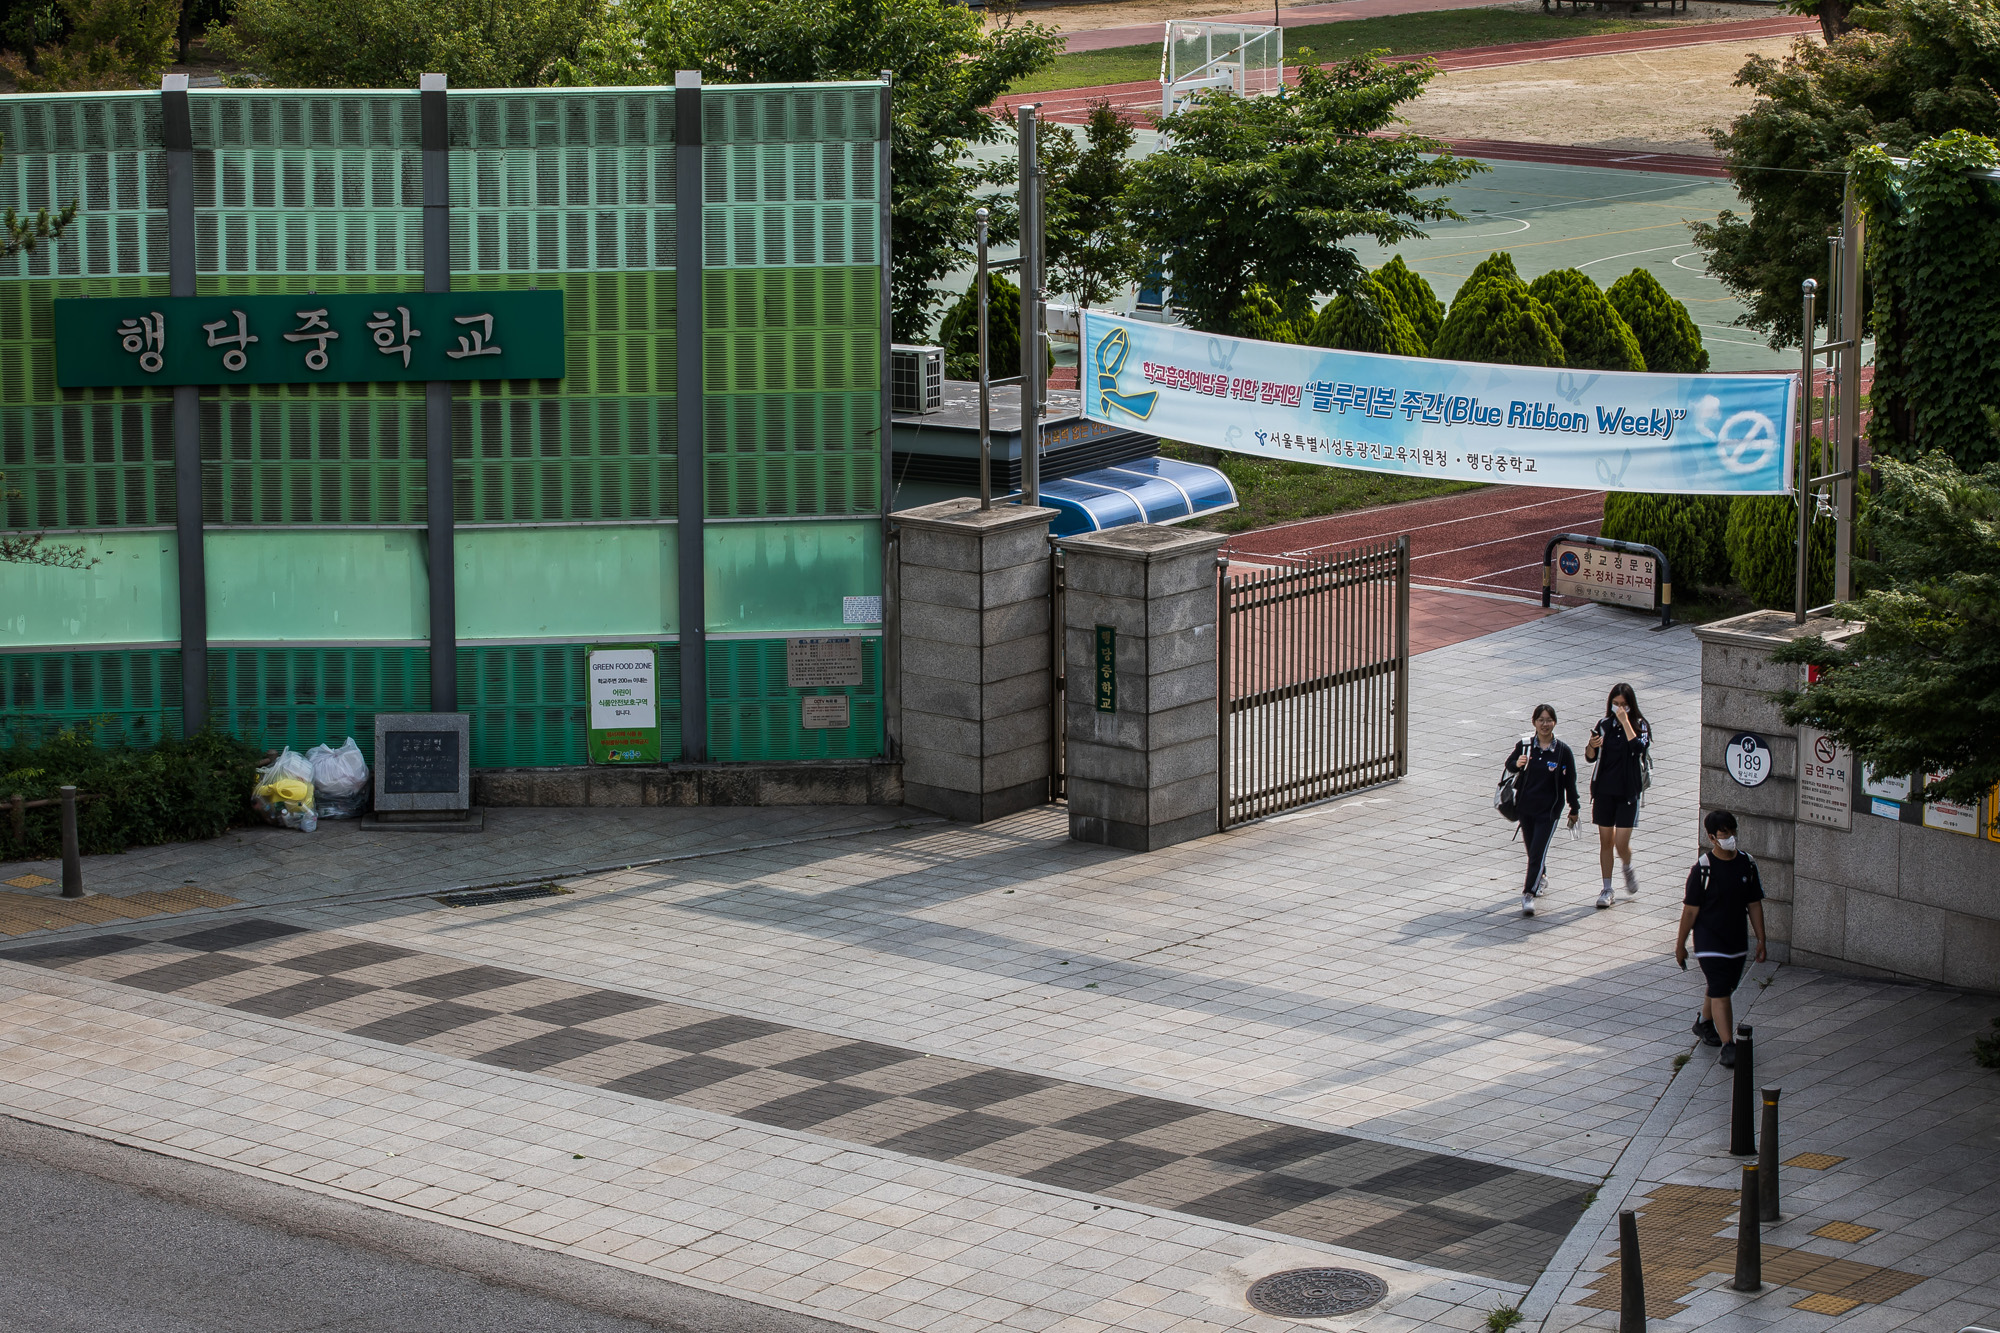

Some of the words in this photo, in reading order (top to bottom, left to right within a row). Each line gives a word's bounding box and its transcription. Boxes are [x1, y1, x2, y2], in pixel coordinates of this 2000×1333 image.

[117, 306, 502, 373] 행당중학교
[1143, 361, 1228, 398] 학교흡연예방을
[1230, 378, 1259, 401] 위한
[1260, 381, 1302, 407] 캠페인
[1507, 399, 1589, 433] Ribbon
[1466, 451, 1538, 474] 행당중학교
[1616, 573, 1653, 589] 금지구역
[635, 662, 652, 670] ZONE
[1737, 753, 1761, 771] 189
[1805, 763, 1845, 783] 금연구역
